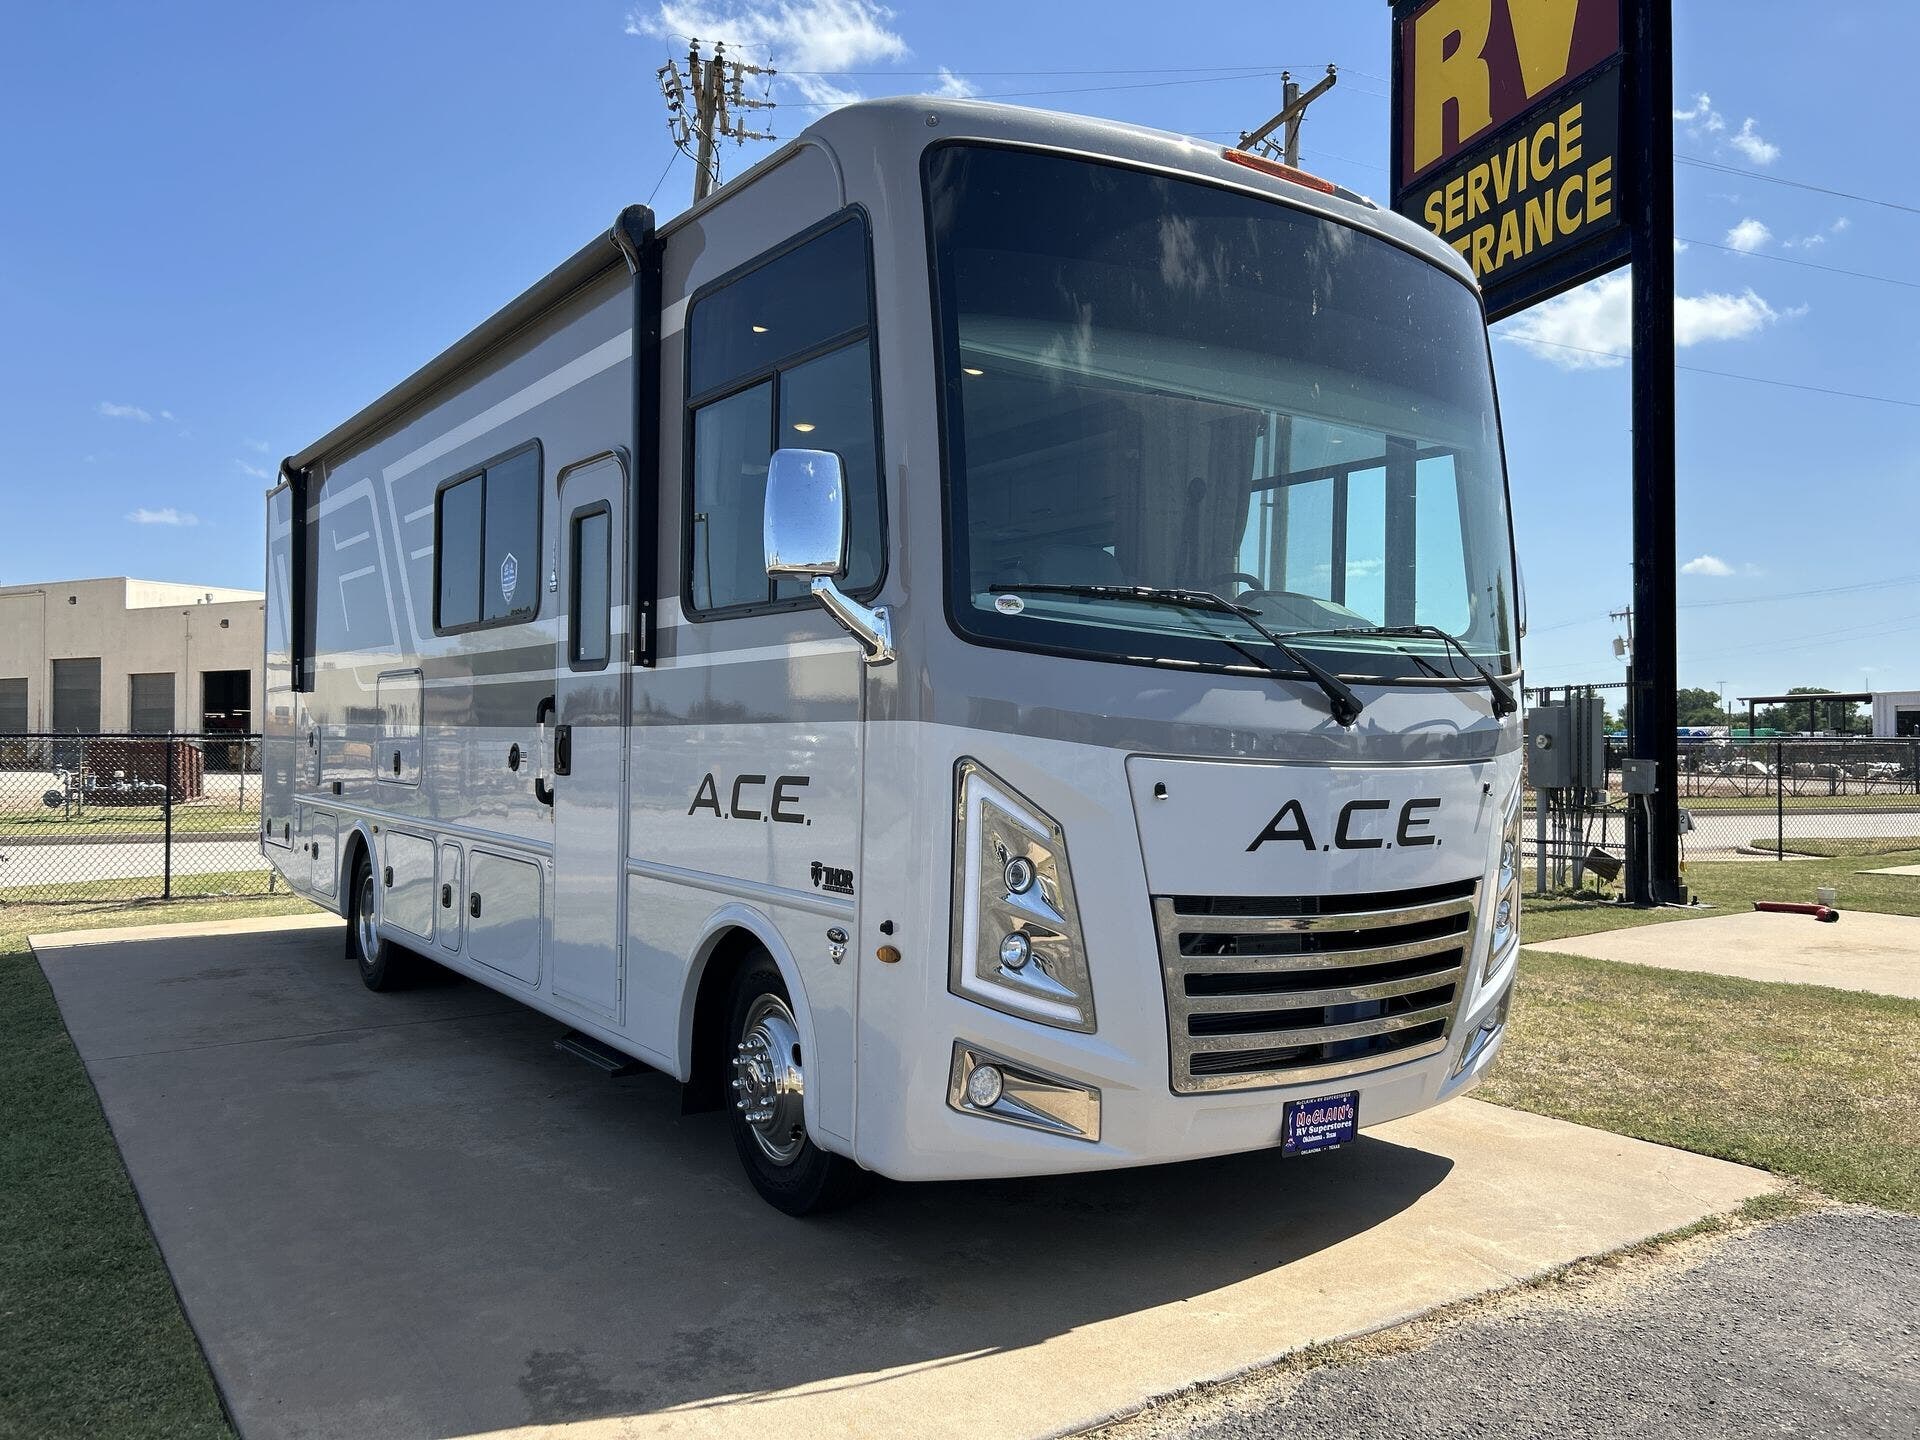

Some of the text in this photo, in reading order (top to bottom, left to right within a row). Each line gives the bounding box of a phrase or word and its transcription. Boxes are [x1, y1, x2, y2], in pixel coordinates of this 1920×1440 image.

[1414, 0, 1580, 173] RV
[1424, 102, 1582, 236] SERVICE
[1450, 155, 1612, 278] TRANCE
[688, 773, 811, 826] A.C.E.
[1245, 798, 1442, 852] A.C.E.
[822, 866, 854, 889] THOR
[1296, 1120, 1352, 1136] RV Superstores
